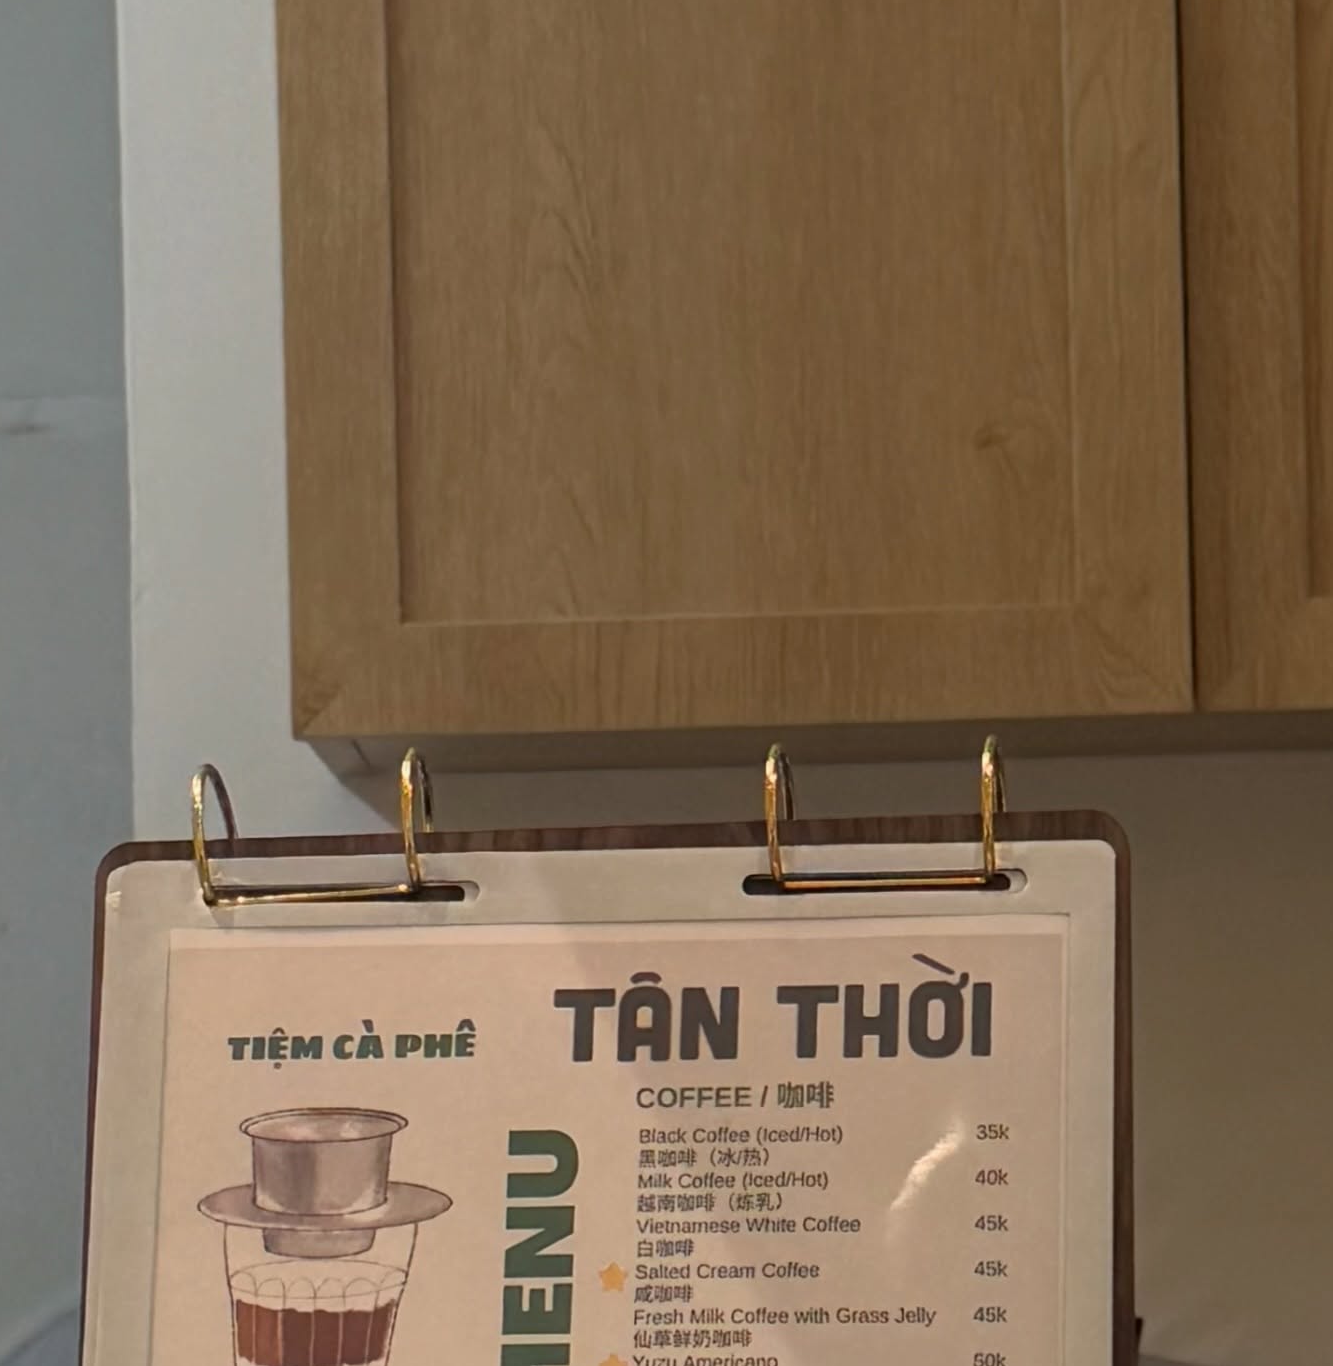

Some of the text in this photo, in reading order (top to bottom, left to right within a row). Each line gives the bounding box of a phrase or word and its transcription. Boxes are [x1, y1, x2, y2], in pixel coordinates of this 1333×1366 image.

[554, 953, 992, 1062] TÂN THỜI
[228, 1019, 476, 1069] TIỆM CÀ PHÊ
[636, 1081, 834, 1109] COFFEE 咖啡
[639, 1124, 1009, 1146] Black Coffee (Iced/Hot) 35k
[638, 1168, 1009, 1191] Milk Coffee (Iced/Hot) 40k
[636, 1215, 1009, 1234] Vietnamese White Coffee 45k
[637, 1239, 694, 1258] 白咖啡
[635, 1260, 1008, 1280] Salted Cream Coffee 45k
[634, 1306, 1007, 1327] Fresh Milk Coffee with Grass Jelly 45k
